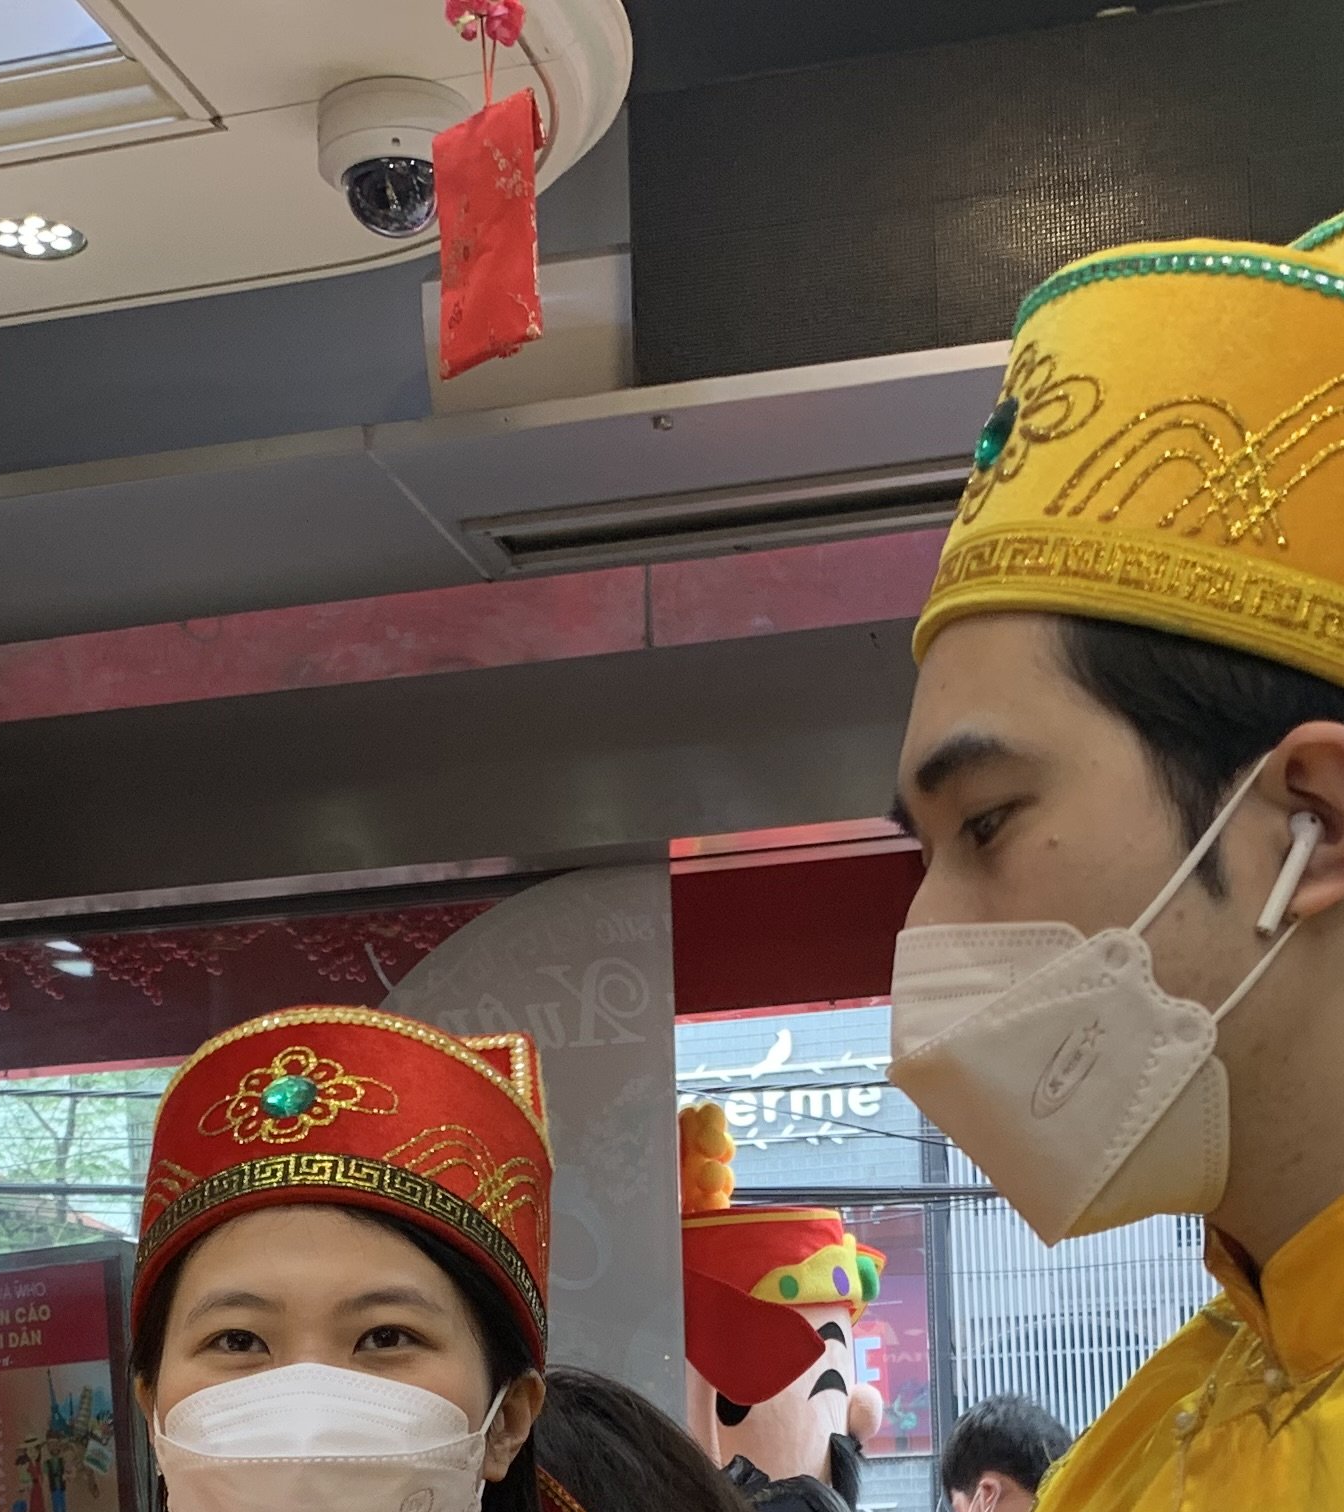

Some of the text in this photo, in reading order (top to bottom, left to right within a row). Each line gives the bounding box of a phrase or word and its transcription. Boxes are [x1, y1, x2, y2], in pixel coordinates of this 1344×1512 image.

[14, 1281, 46, 1299] WHO
[14, 1303, 51, 1324] CÁO
[8, 1330, 43, 1349] DÂN
